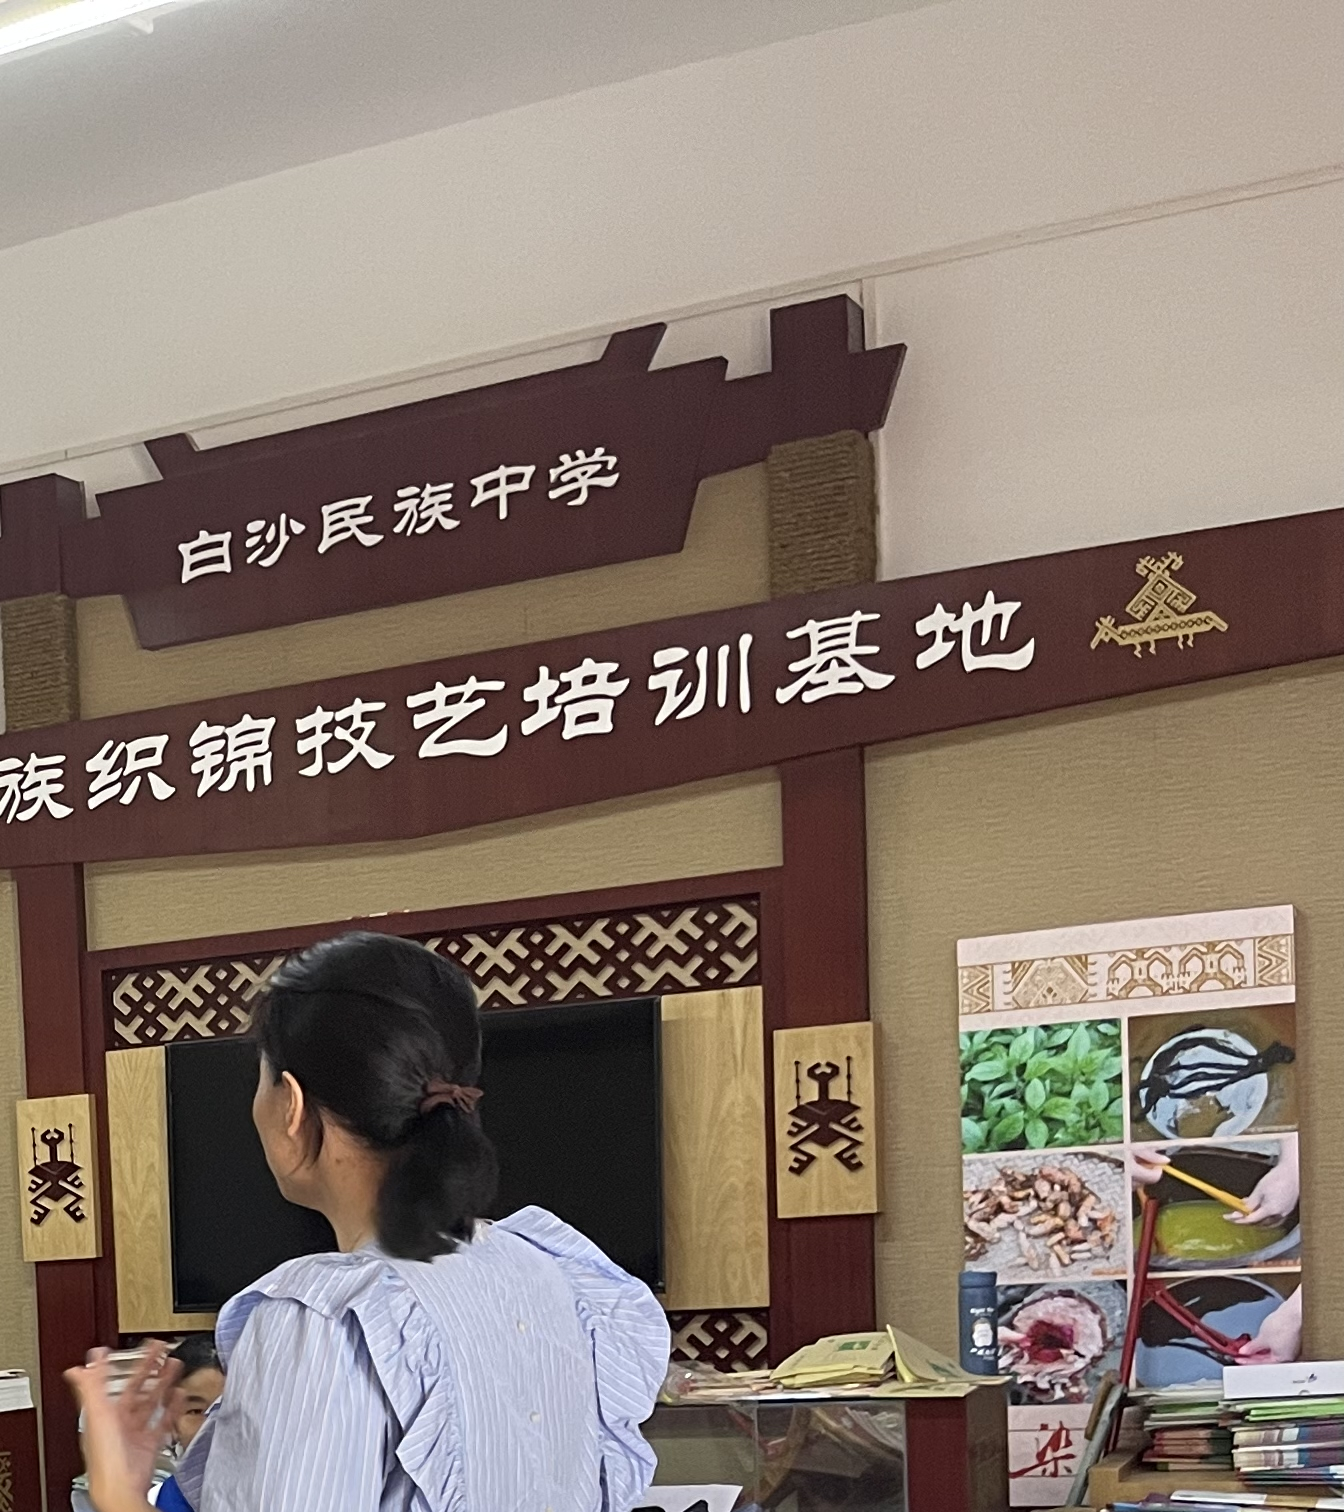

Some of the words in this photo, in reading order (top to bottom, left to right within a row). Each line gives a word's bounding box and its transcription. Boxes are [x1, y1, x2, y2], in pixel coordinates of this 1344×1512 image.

[176, 446, 621, 584] 白沙民族中学
[1009, 1421, 1076, 1479] 染
